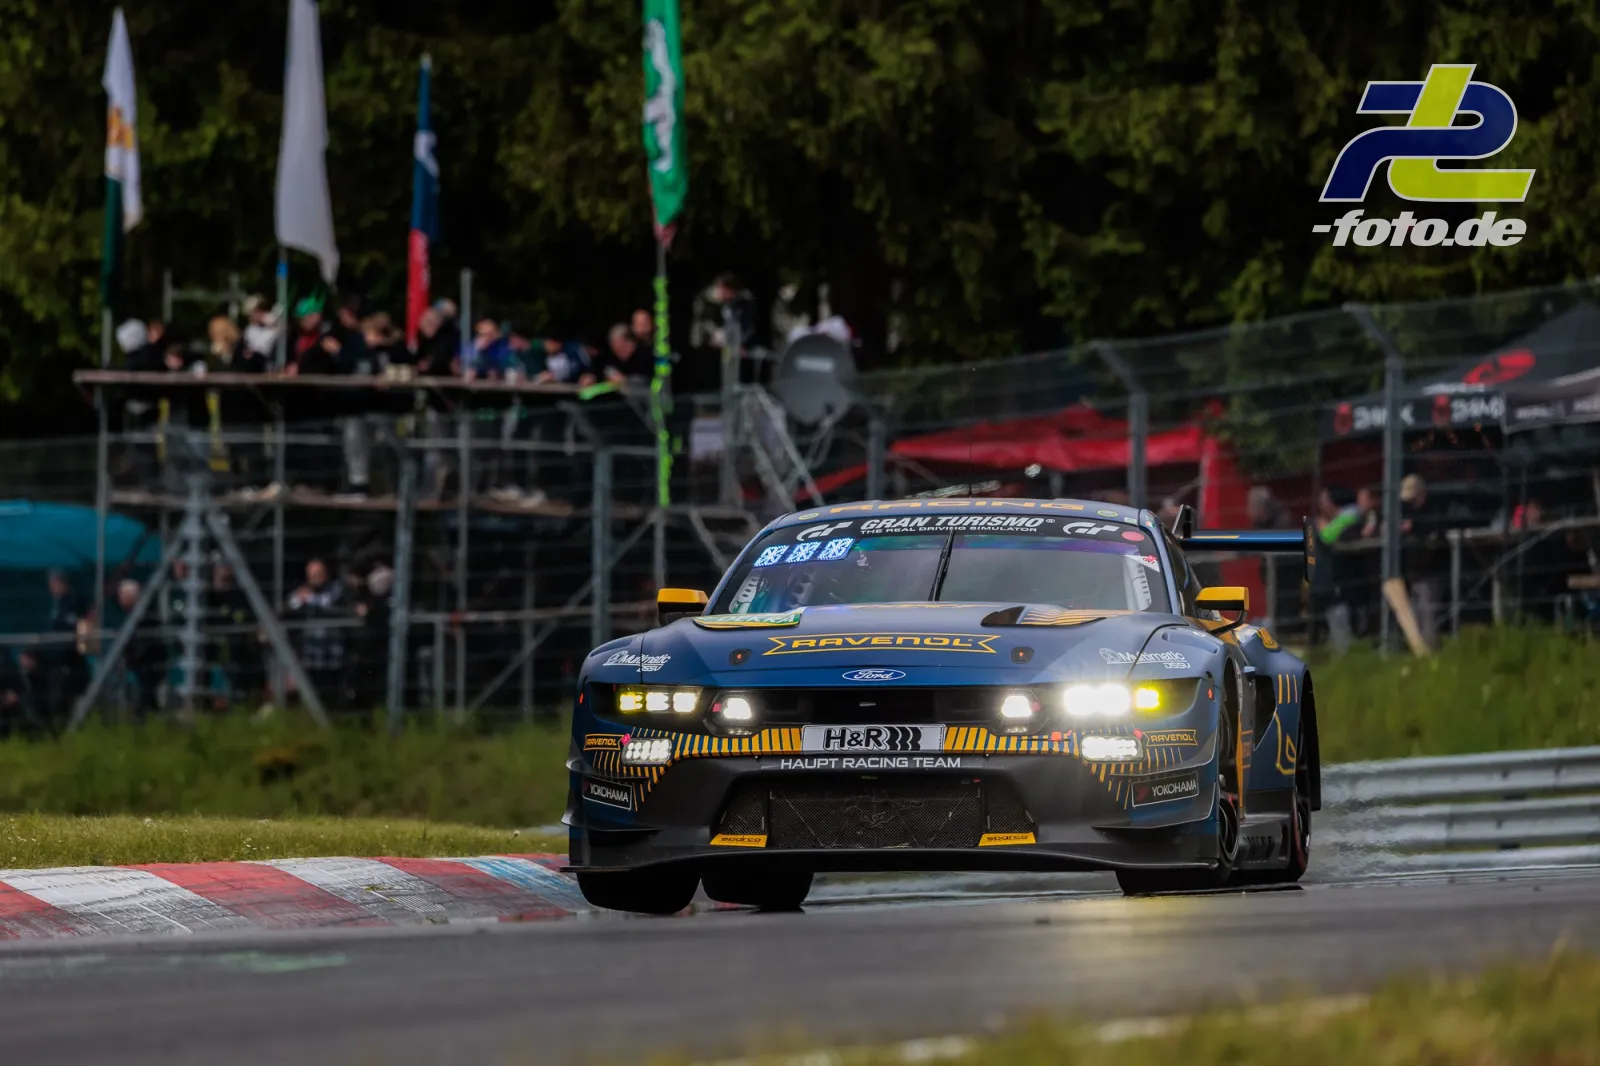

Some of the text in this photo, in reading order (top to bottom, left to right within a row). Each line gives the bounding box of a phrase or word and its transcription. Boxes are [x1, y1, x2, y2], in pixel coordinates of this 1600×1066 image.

[861, 516, 930, 530] GRAN
[791, 636, 973, 649] RAVENOL
[1116, 651, 1185, 661] Multimatic
[853, 669, 894, 681] Ford
[824, 726, 887, 751] H&R
[1150, 733, 1194, 742] RAVENOL
[780, 757, 961, 770] HAUPT RACING TEAM
[590, 783, 629, 802] YOKOHAMA
[1152, 779, 1197, 796] YOKOHAMA
